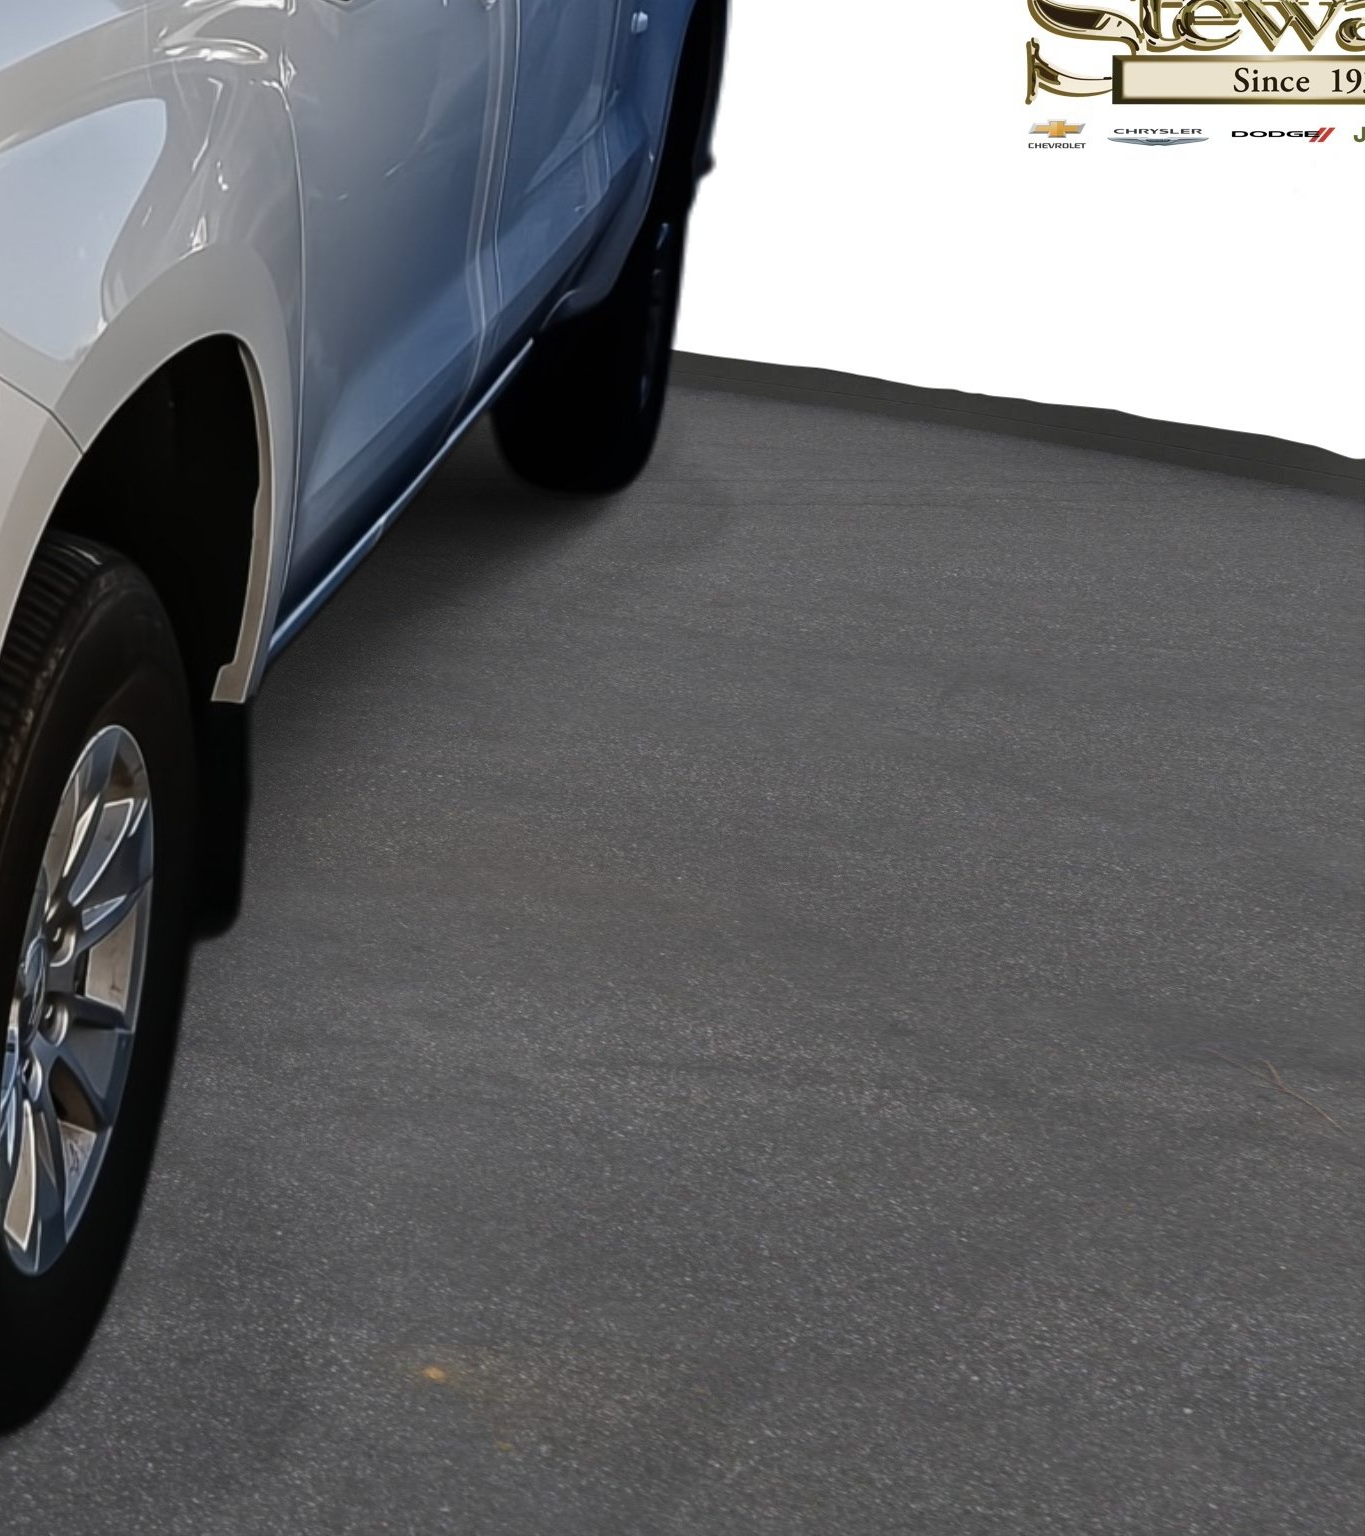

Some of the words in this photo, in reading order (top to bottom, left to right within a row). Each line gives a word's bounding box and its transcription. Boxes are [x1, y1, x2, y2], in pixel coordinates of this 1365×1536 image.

[1233, 67, 1310, 93] Since
[1331, 68, 1365, 94] 19
[1027, 142, 1087, 150] CHEVROLET
[1113, 128, 1203, 136] CHRYSLER
[1231, 130, 1320, 139] DODGE
